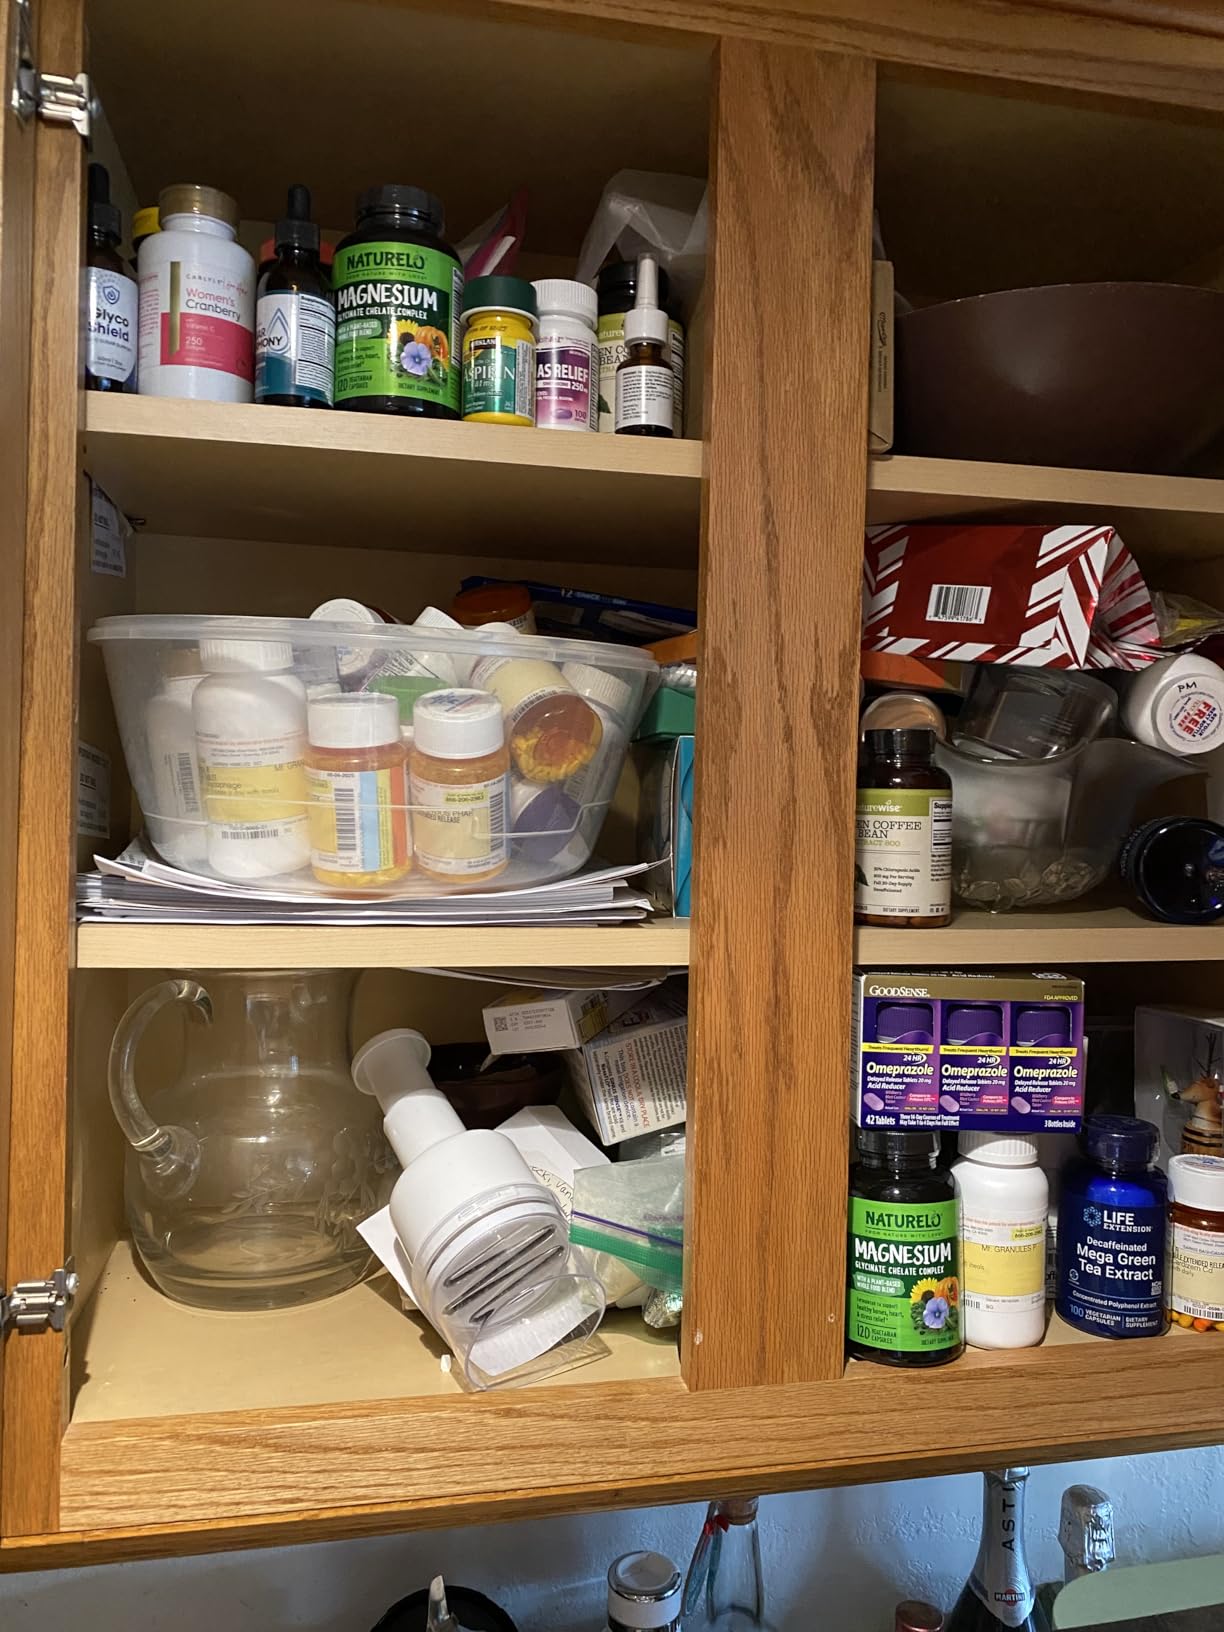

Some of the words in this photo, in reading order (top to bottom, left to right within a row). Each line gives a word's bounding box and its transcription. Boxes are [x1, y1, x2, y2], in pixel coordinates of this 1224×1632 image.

[347, 251, 425, 271] NATURELO
[187, 287, 235, 307] Women's
[337, 283, 438, 312] MAGNESIUM
[185, 298, 240, 322] Cranberry
[365, 306, 396, 318] CHELATE
[396, 308, 428, 320] COMPLEX
[88, 321, 129, 342] Shield
[185, 336, 203, 346] 250
[553, 364, 589, 383] RELIEF
[571, 382, 584, 391] 250
[575, 410, 587, 419] 100
[1177, 681, 1197, 693] PM
[1183, 701, 1212, 735] FREE
[873, 820, 922, 831] COFFEE
[858, 829, 888, 839] BEAN
[866, 1062, 934, 1077] Omeprazole
[942, 1064, 1008, 1079] Omeprazole
[1013, 1066, 1078, 1080] Omeprazole
[641, 1110, 649, 1128] PLACE
[866, 1114, 875, 1125] 42
[875, 1116, 896, 1125] Tablets
[1048, 1120, 1063, 1128] Bottles
[1063, 1120, 1076, 1128] Inside
[865, 1211, 941, 1228] NATURELO
[1103, 1210, 1134, 1225] LIFE
[1103, 1224, 1152, 1233] EXTENSION
[855, 1237, 951, 1265] MAGNESIUM
[1086, 1236, 1147, 1252] Decaffeinated
[1077, 1243, 1113, 1265] Mega
[1118, 1253, 1156, 1266] Green
[855, 1261, 886, 1274] GLYCINATE
[888, 1266, 917, 1276] CHELATE
[918, 1265, 944, 1275] COMPLEX
[1079, 1258, 1102, 1276] Tea
[1105, 1266, 1153, 1280] Extract
[857, 1282, 869, 1290] WHOLE
[871, 1278, 901, 1287] PLANT-BASED
[1072, 1290, 1107, 1305] Concentrated
[1108, 1300, 1140, 1310] Polyphenol
[857, 1304, 872, 1313] healthy
[873, 1307, 889, 1317] bones,
[1070, 1304, 1084, 1317] 100
[1085, 1309, 1120, 1321] VEGETARIAN
[1085, 1314, 1115, 1326] CAPSULES
[1125, 1320, 1158, 1328] SUPPLEMENT
[857, 1324, 871, 1339] 120
[871, 1329, 897, 1338] VEGETARIAN
[871, 1336, 893, 1344] CAPSULES
[1002, 1486, 1015, 1552] ASTI
[995, 1592, 1025, 1602] MARTINI
